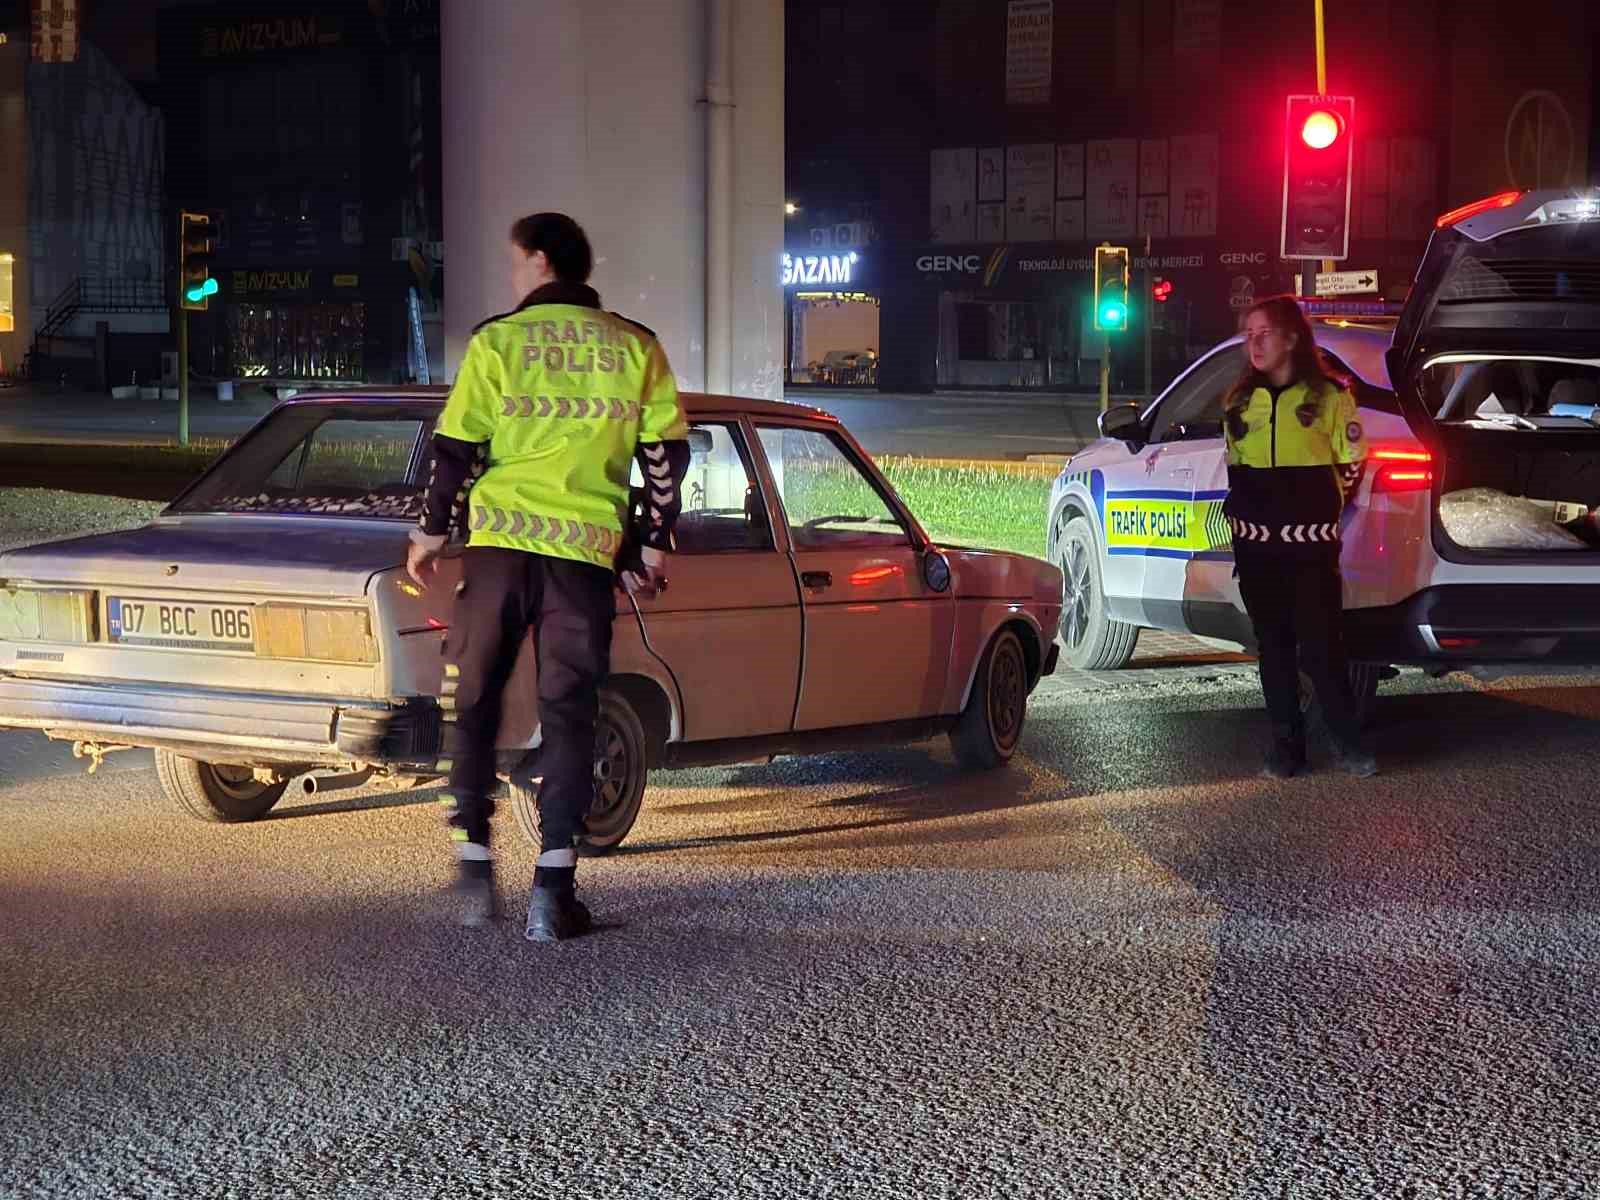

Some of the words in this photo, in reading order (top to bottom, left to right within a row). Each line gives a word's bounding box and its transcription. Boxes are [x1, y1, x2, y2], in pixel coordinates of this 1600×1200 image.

[915, 255, 981, 274] GENÇ
[522, 345, 626, 374] POLİSİ
[1111, 505, 1147, 536] TRAFİK
[1151, 506, 1186, 539] POLİSİ
[121, 603, 145, 633] 07
[160, 605, 197, 636] BCC
[211, 608, 251, 639] 086
